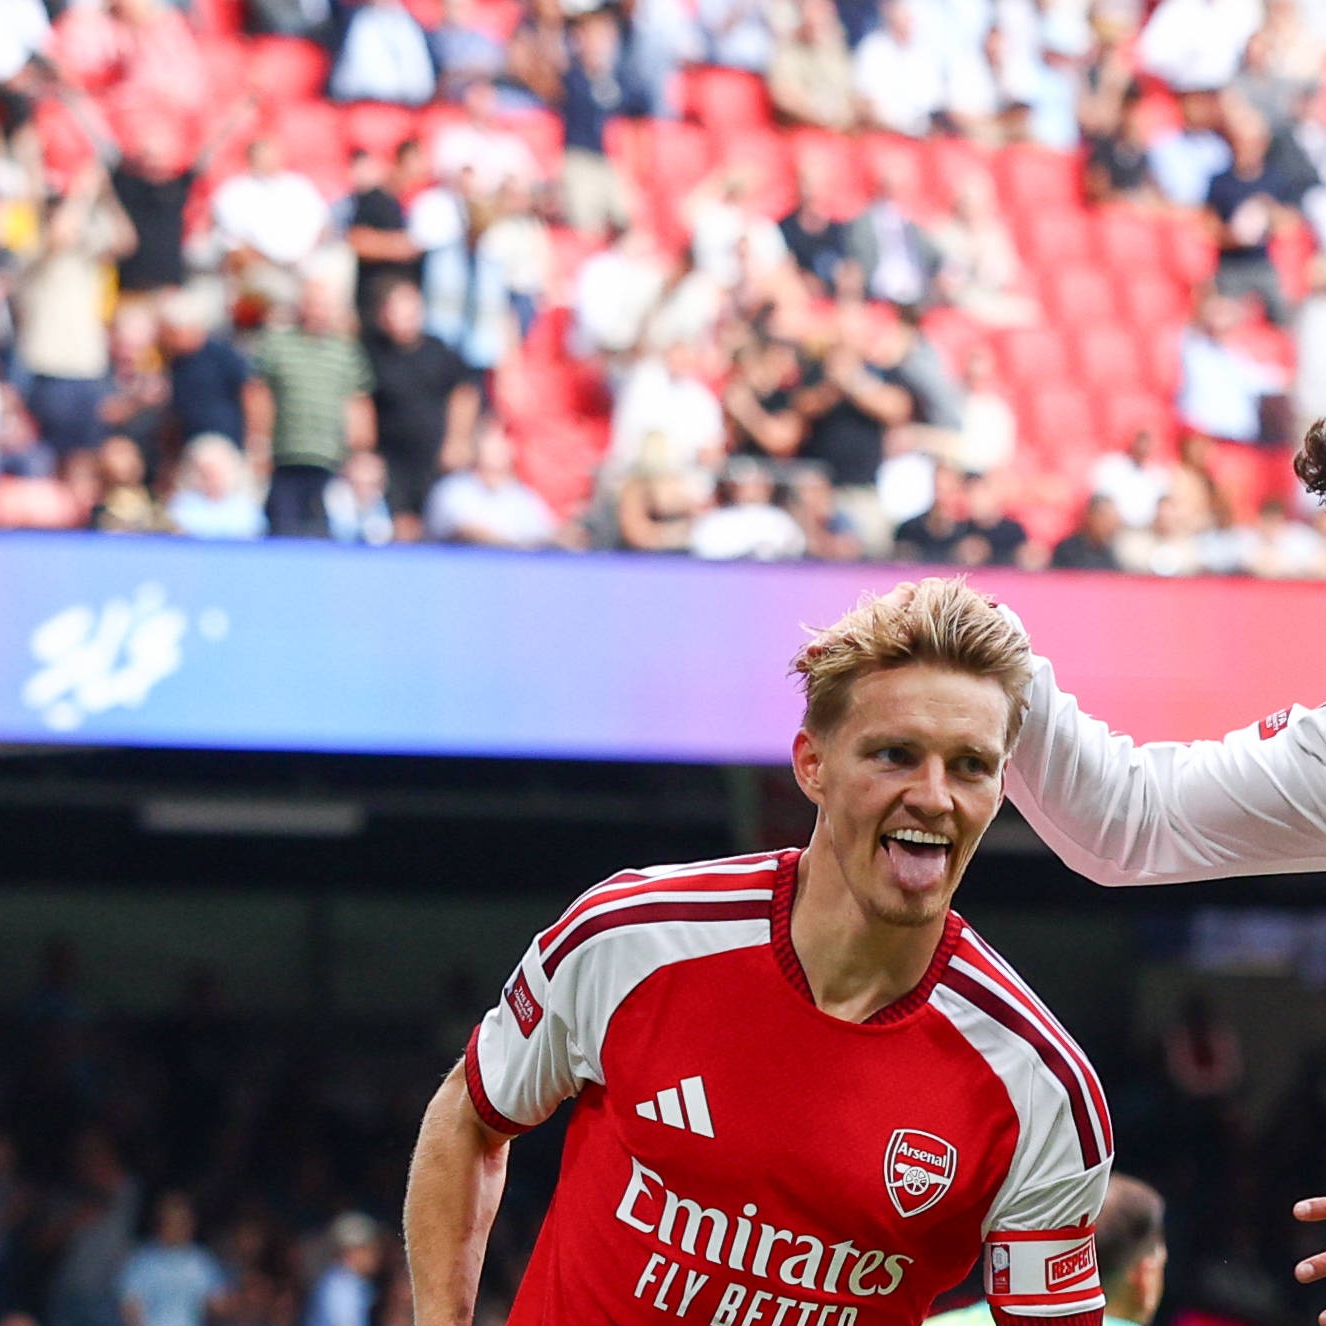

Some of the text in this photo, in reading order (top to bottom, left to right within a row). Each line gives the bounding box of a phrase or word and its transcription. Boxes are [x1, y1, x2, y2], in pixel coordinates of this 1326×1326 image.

[897, 1141, 947, 1169] Arsenal
[615, 1156, 914, 1296] Emirates
[634, 1252, 710, 1318] FLY
[1052, 1245, 1092, 1281] RESPECT
